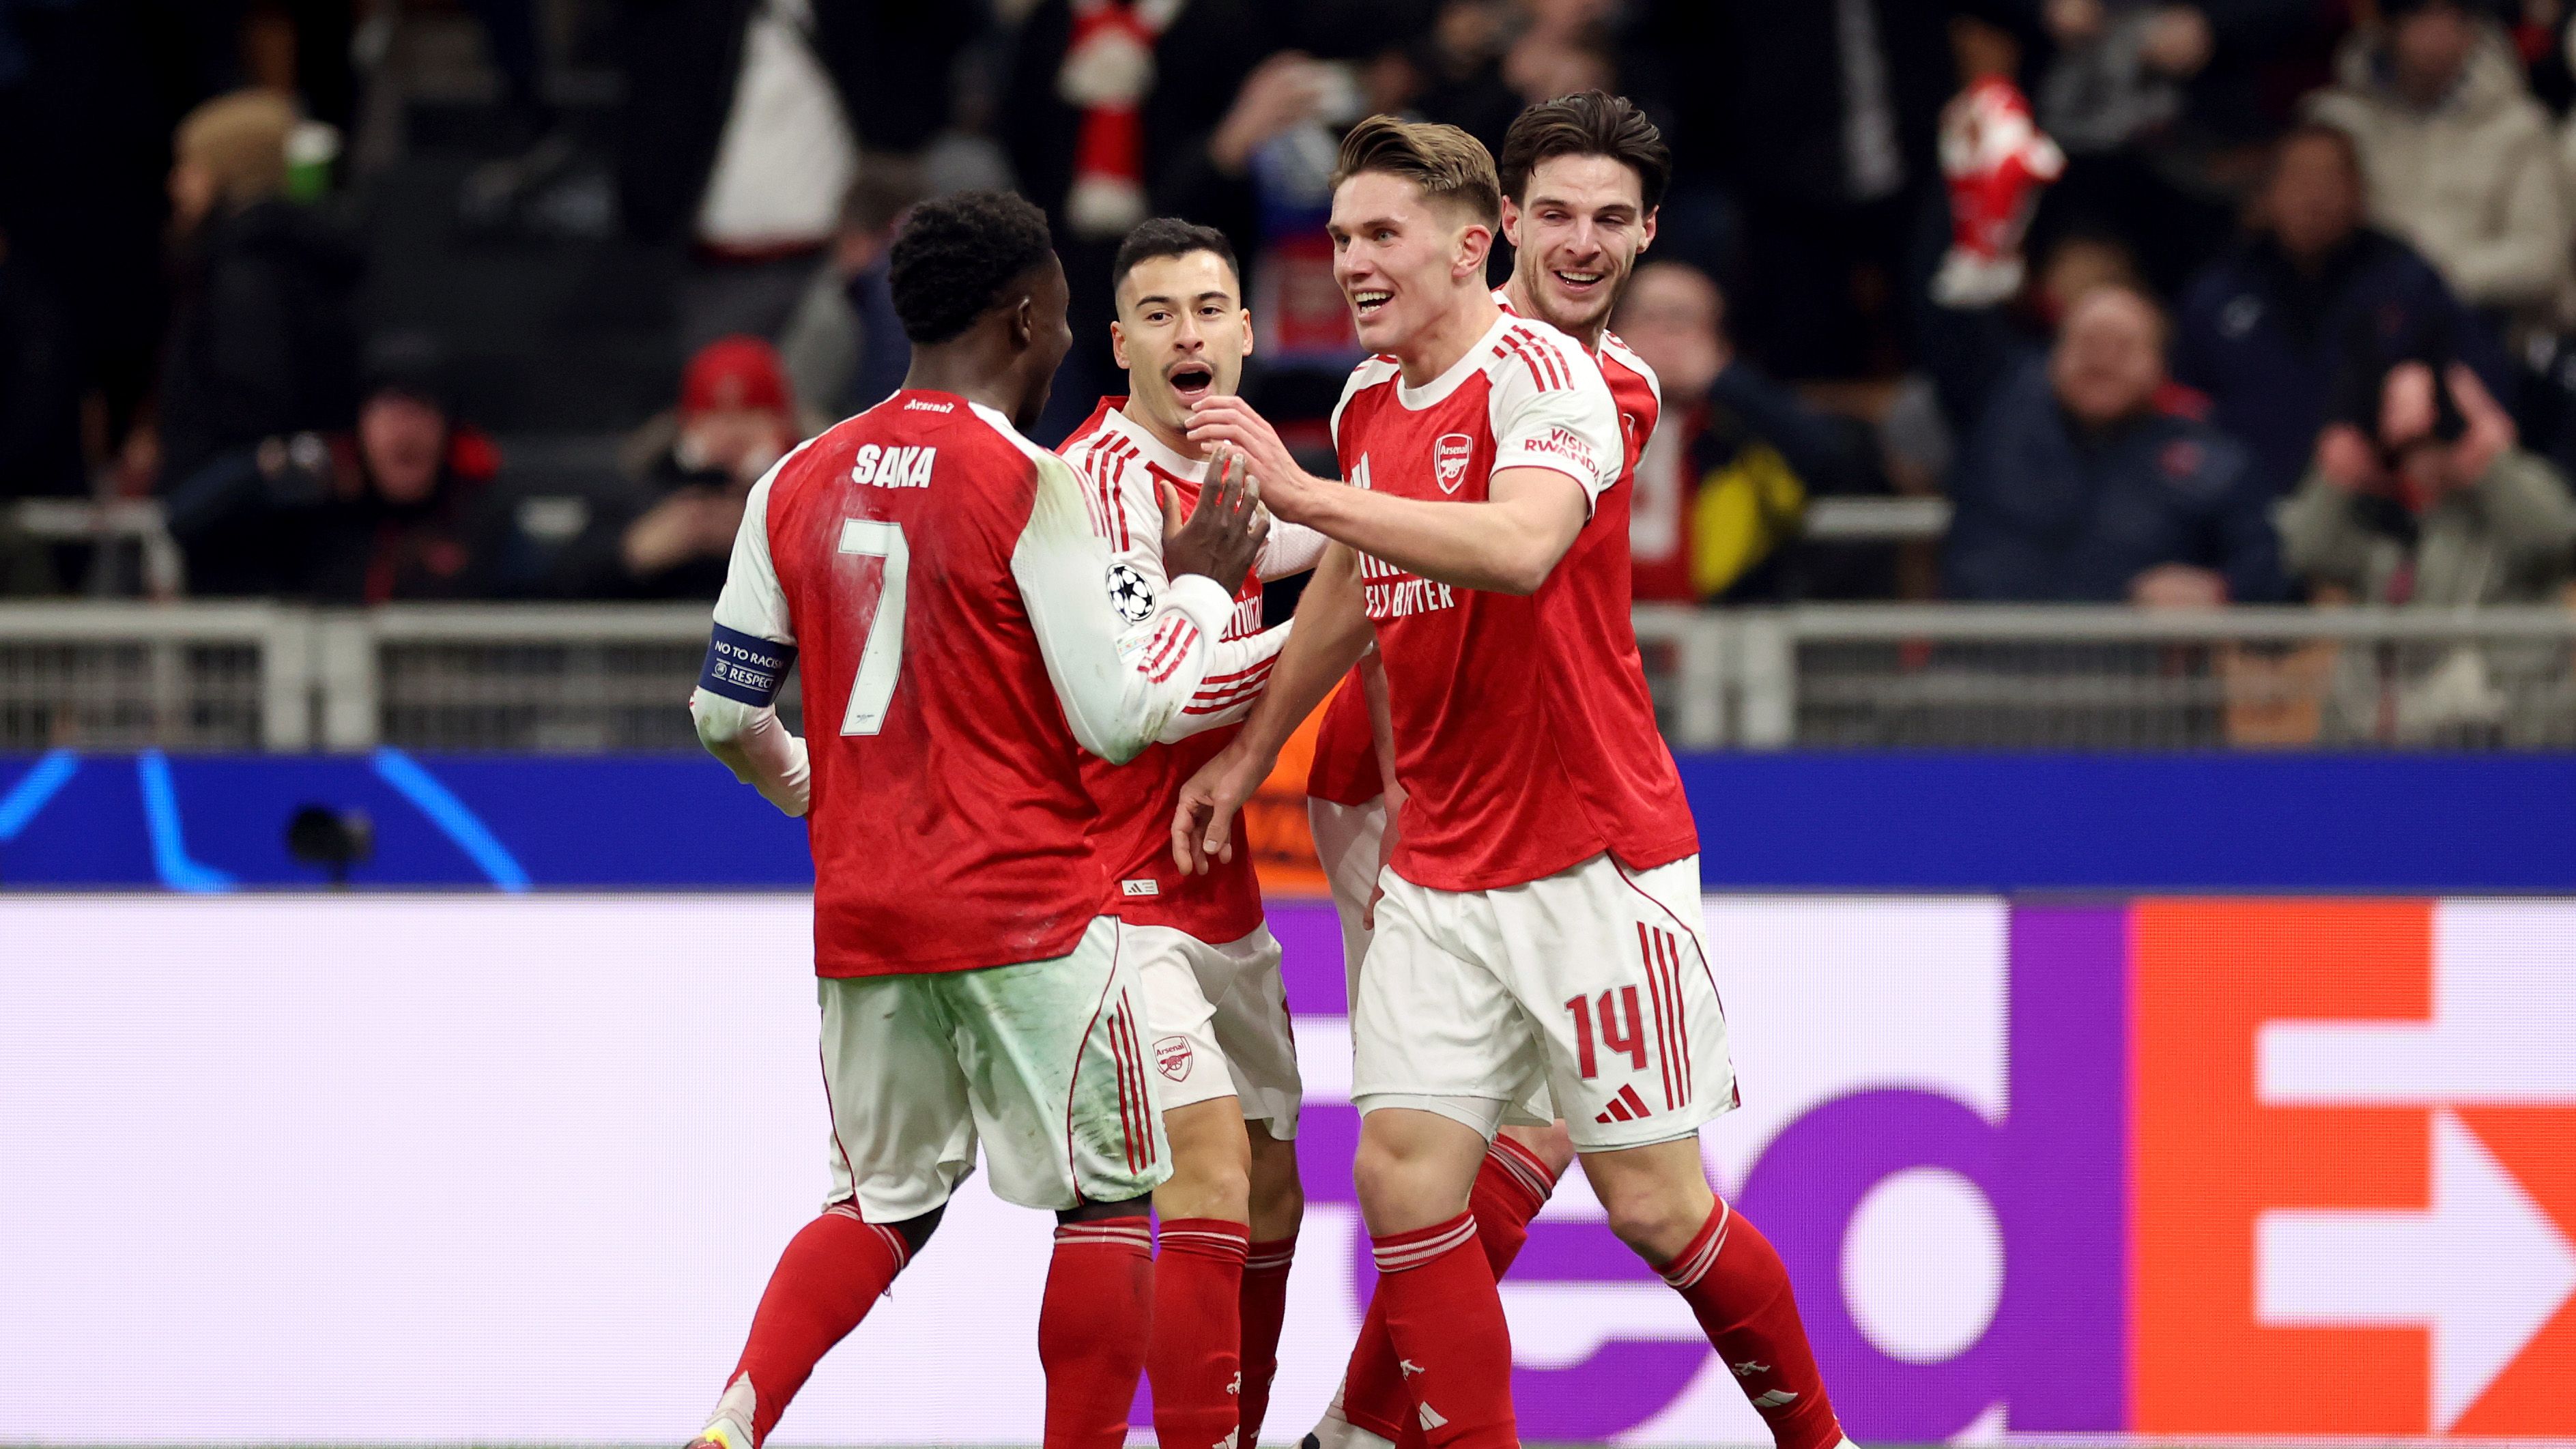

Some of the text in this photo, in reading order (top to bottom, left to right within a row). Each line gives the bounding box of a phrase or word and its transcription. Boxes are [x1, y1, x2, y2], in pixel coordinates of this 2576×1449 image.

[1440, 444, 1468, 455] Arsenal
[1551, 427, 1592, 456] VISIT
[851, 443, 937, 489] SAKA
[1365, 584, 1390, 618] FLY
[838, 518, 910, 736] 7
[715, 640, 730, 654] NO
[732, 646, 749, 660] TO
[1564, 984, 1649, 1081] 14
[1156, 1042, 1185, 1057] Arsenal
